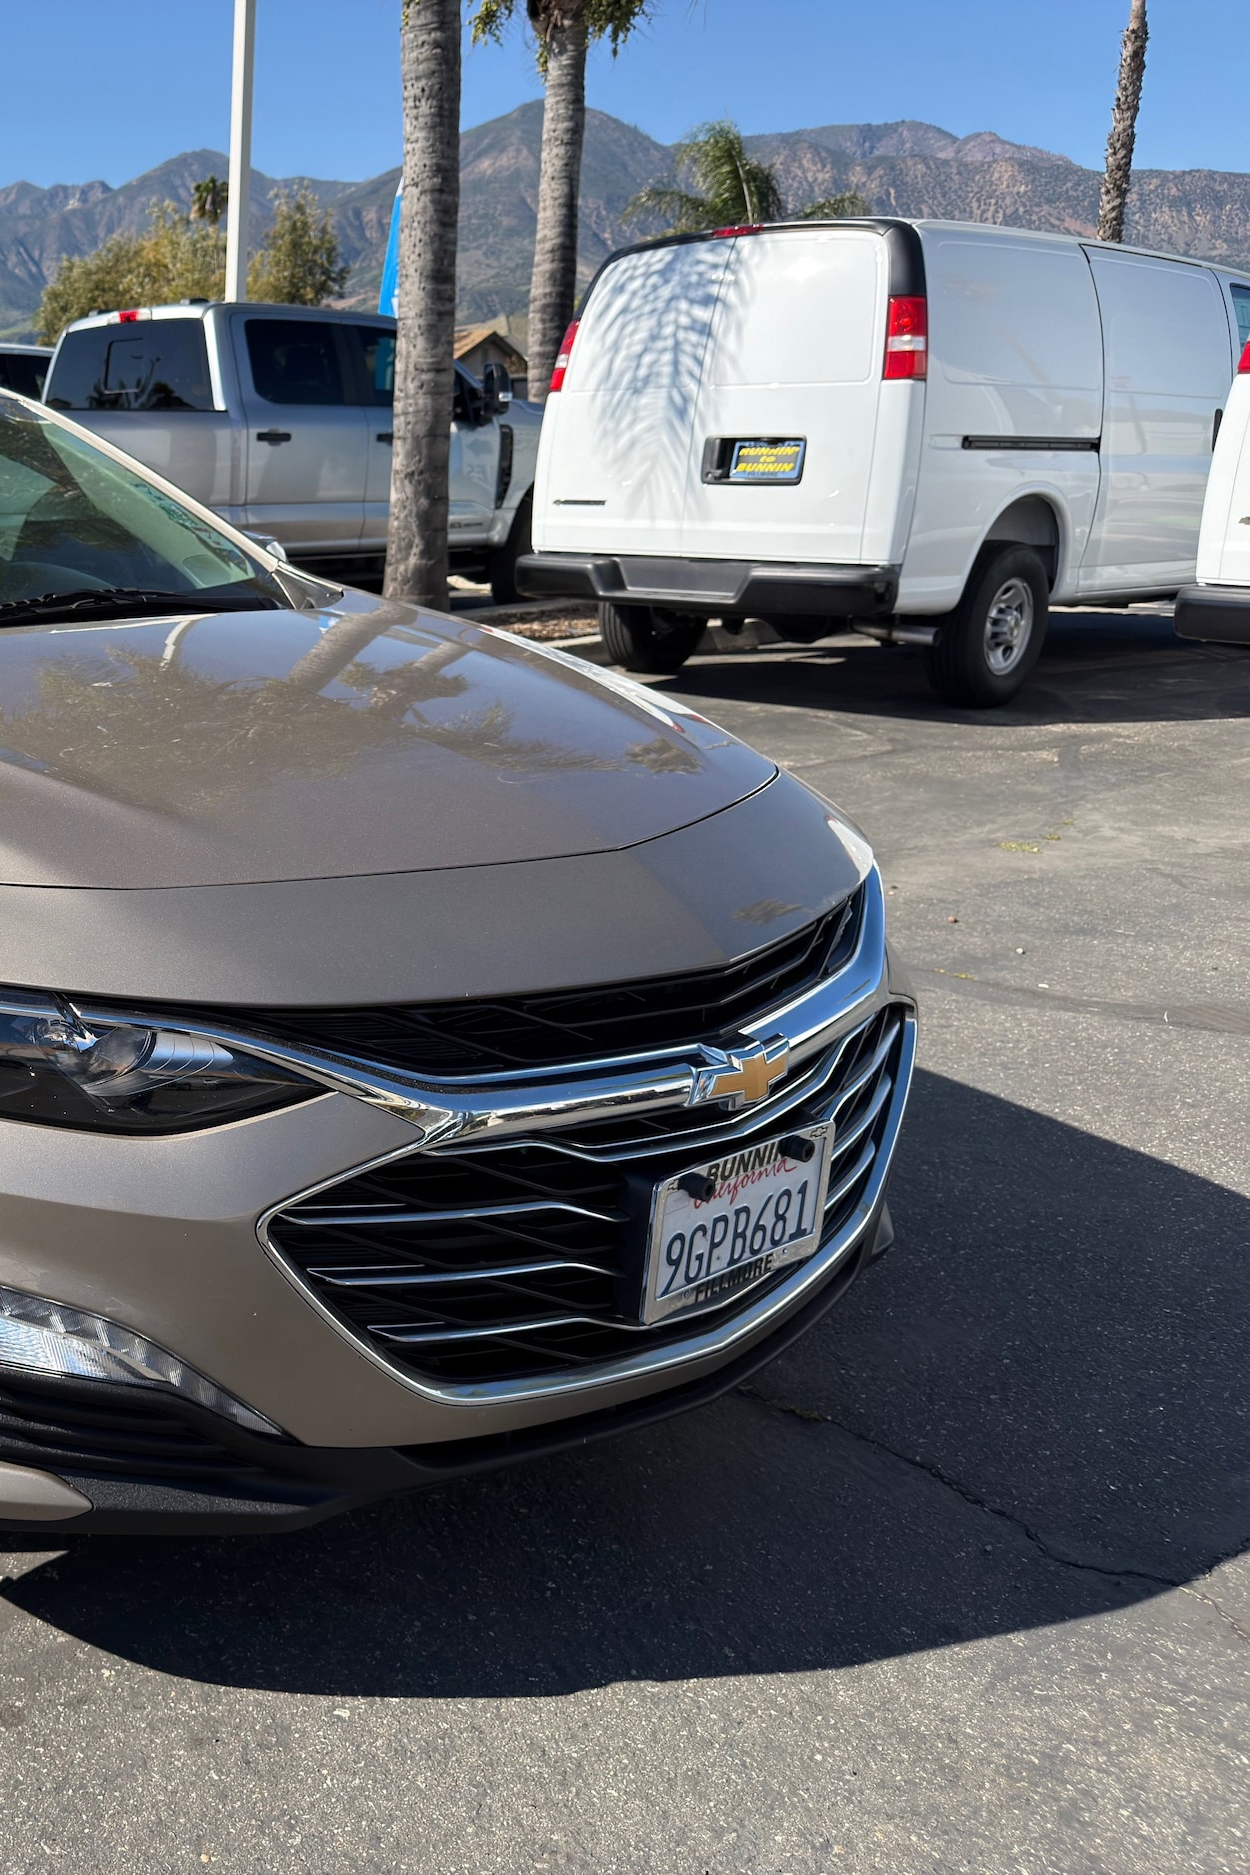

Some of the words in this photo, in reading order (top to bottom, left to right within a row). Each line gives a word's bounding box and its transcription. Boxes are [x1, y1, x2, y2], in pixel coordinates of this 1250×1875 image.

[735, 462, 795, 472] BUNNIN
[694, 1157, 798, 1210] lifornia
[661, 1179, 809, 1299] 9GPB681
